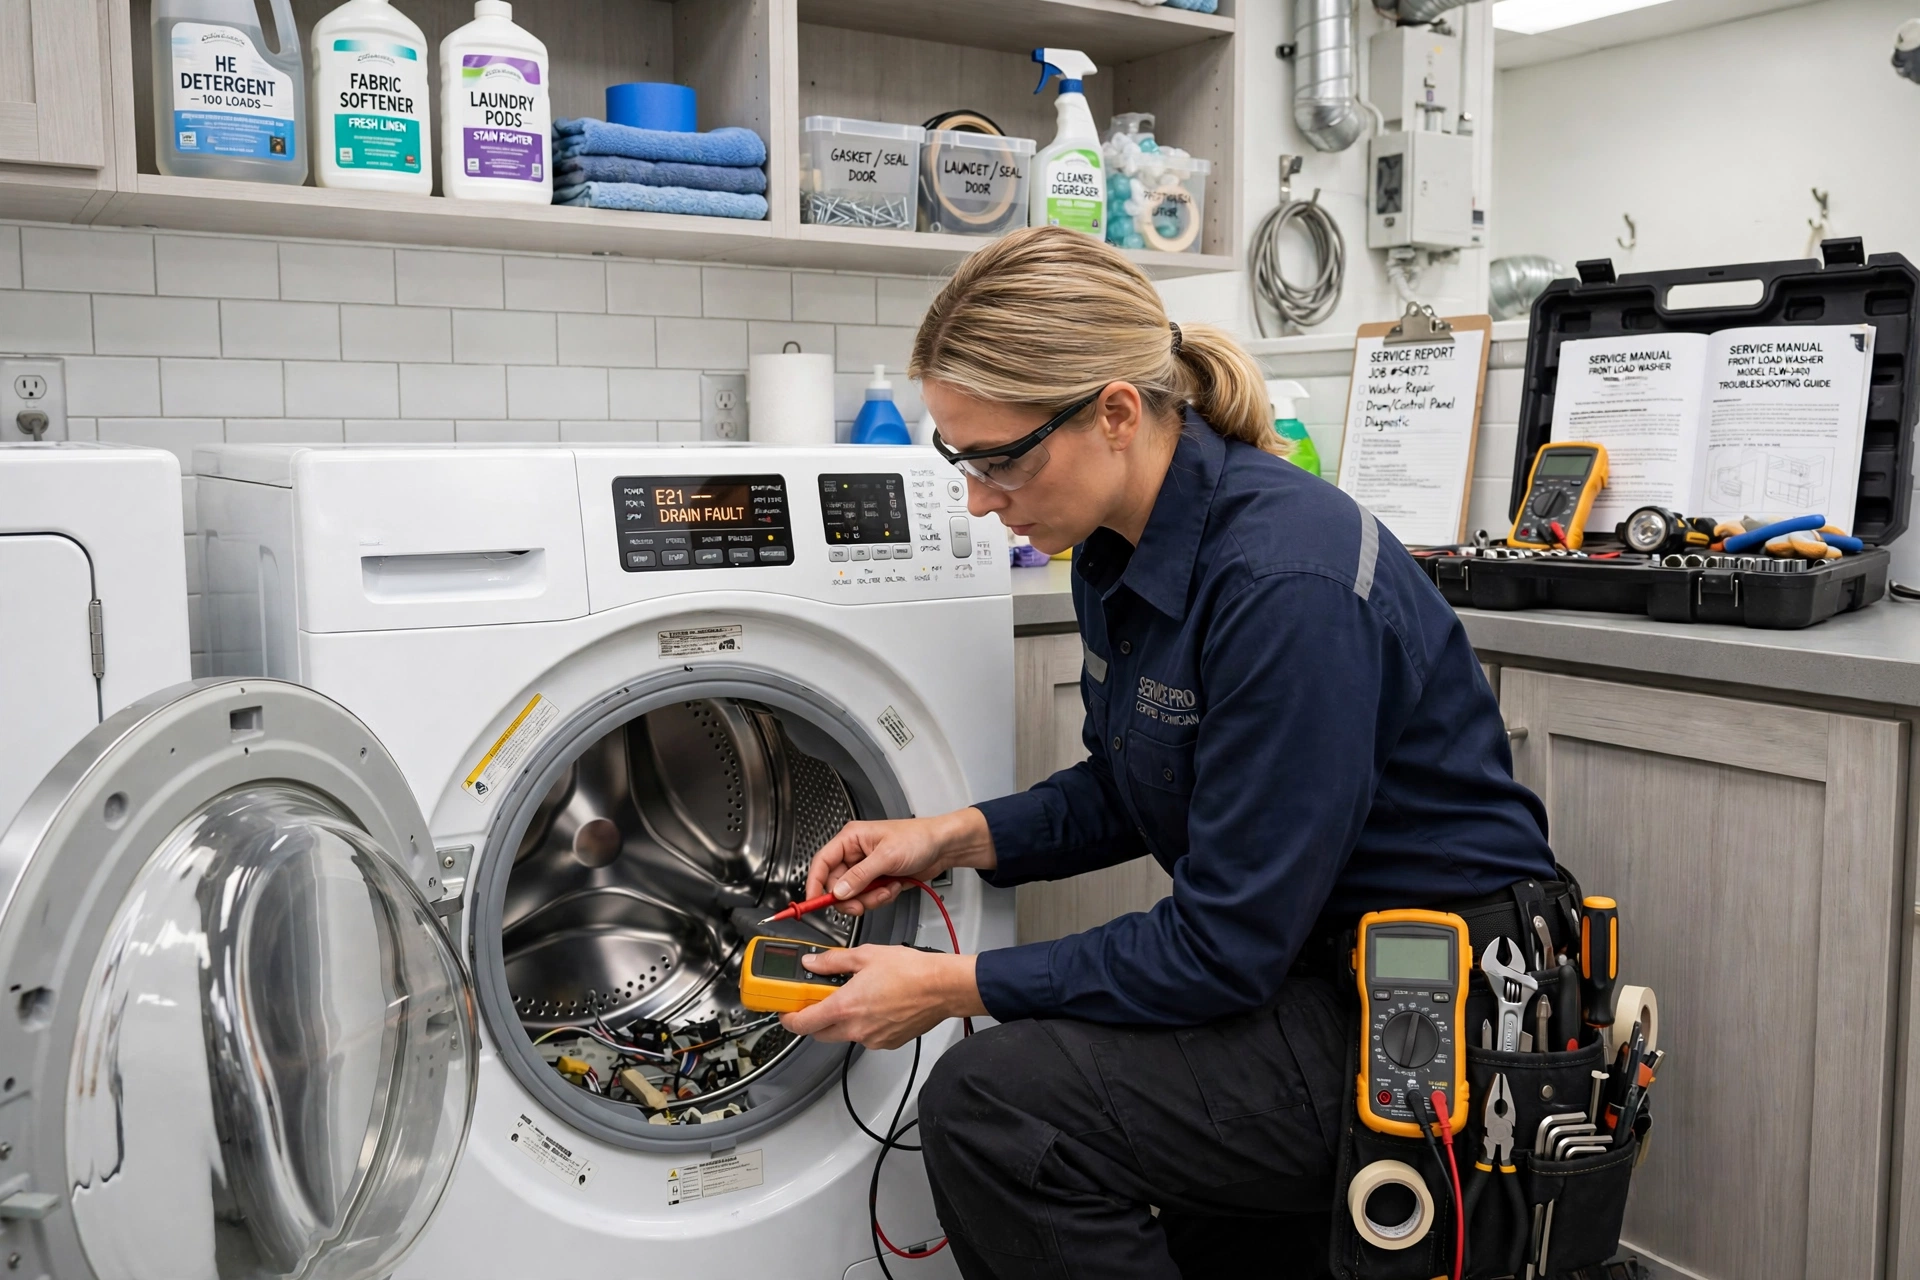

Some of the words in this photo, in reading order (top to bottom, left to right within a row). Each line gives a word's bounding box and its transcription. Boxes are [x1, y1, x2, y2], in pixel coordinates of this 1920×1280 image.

[215, 55, 237, 73] HE
[181, 72, 275, 97] DETERGENT
[350, 73, 402, 93] FABRIC
[203, 94, 222, 105] 100
[226, 96, 261, 109] LOADS
[340, 92, 414, 114] SOFTENER
[471, 91, 535, 112] LAUNDRY
[349, 118, 378, 130] FRESH
[380, 121, 407, 132] LINEN
[485, 110, 522, 128] PODS
[473, 131, 498, 142] STAIN
[831, 148, 872, 164] GASKET
[884, 153, 909, 166] SEAL
[849, 169, 877, 183] DOOR
[999, 165, 1022, 179] SEAL
[1056, 172, 1094, 184] CLEANER
[965, 181, 991, 195] DOOR
[1052, 184, 1100, 197] DEGREASER
[1370, 349, 1412, 363] SERVICE
[1414, 346, 1455, 361] REPORT
[1729, 343, 1774, 355] SERVICE
[1776, 342, 1824, 353] MANUAL
[1589, 353, 1627, 364] SERVICE
[1629, 350, 1672, 361] MANUAL
[1728, 356, 1756, 366] FRONT
[1758, 355, 1783, 365] LOAD
[1785, 355, 1824, 364] WASHER
[1368, 366, 1387, 379] JOB
[1588, 366, 1613, 375] FRONT
[1614, 364, 1635, 374] LOAD
[1638, 362, 1672, 372] WASHER
[1737, 367, 1765, 377] MODEL
[1368, 382, 1402, 395] Washer
[1405, 381, 1435, 397] Repair
[1719, 379, 1801, 390] TROUBLESHOOTING
[1430, 396, 1456, 410] Panel
[655, 488, 684, 506] E21
[659, 507, 701, 523] DRAIN
[704, 506, 745, 522] FAULT
